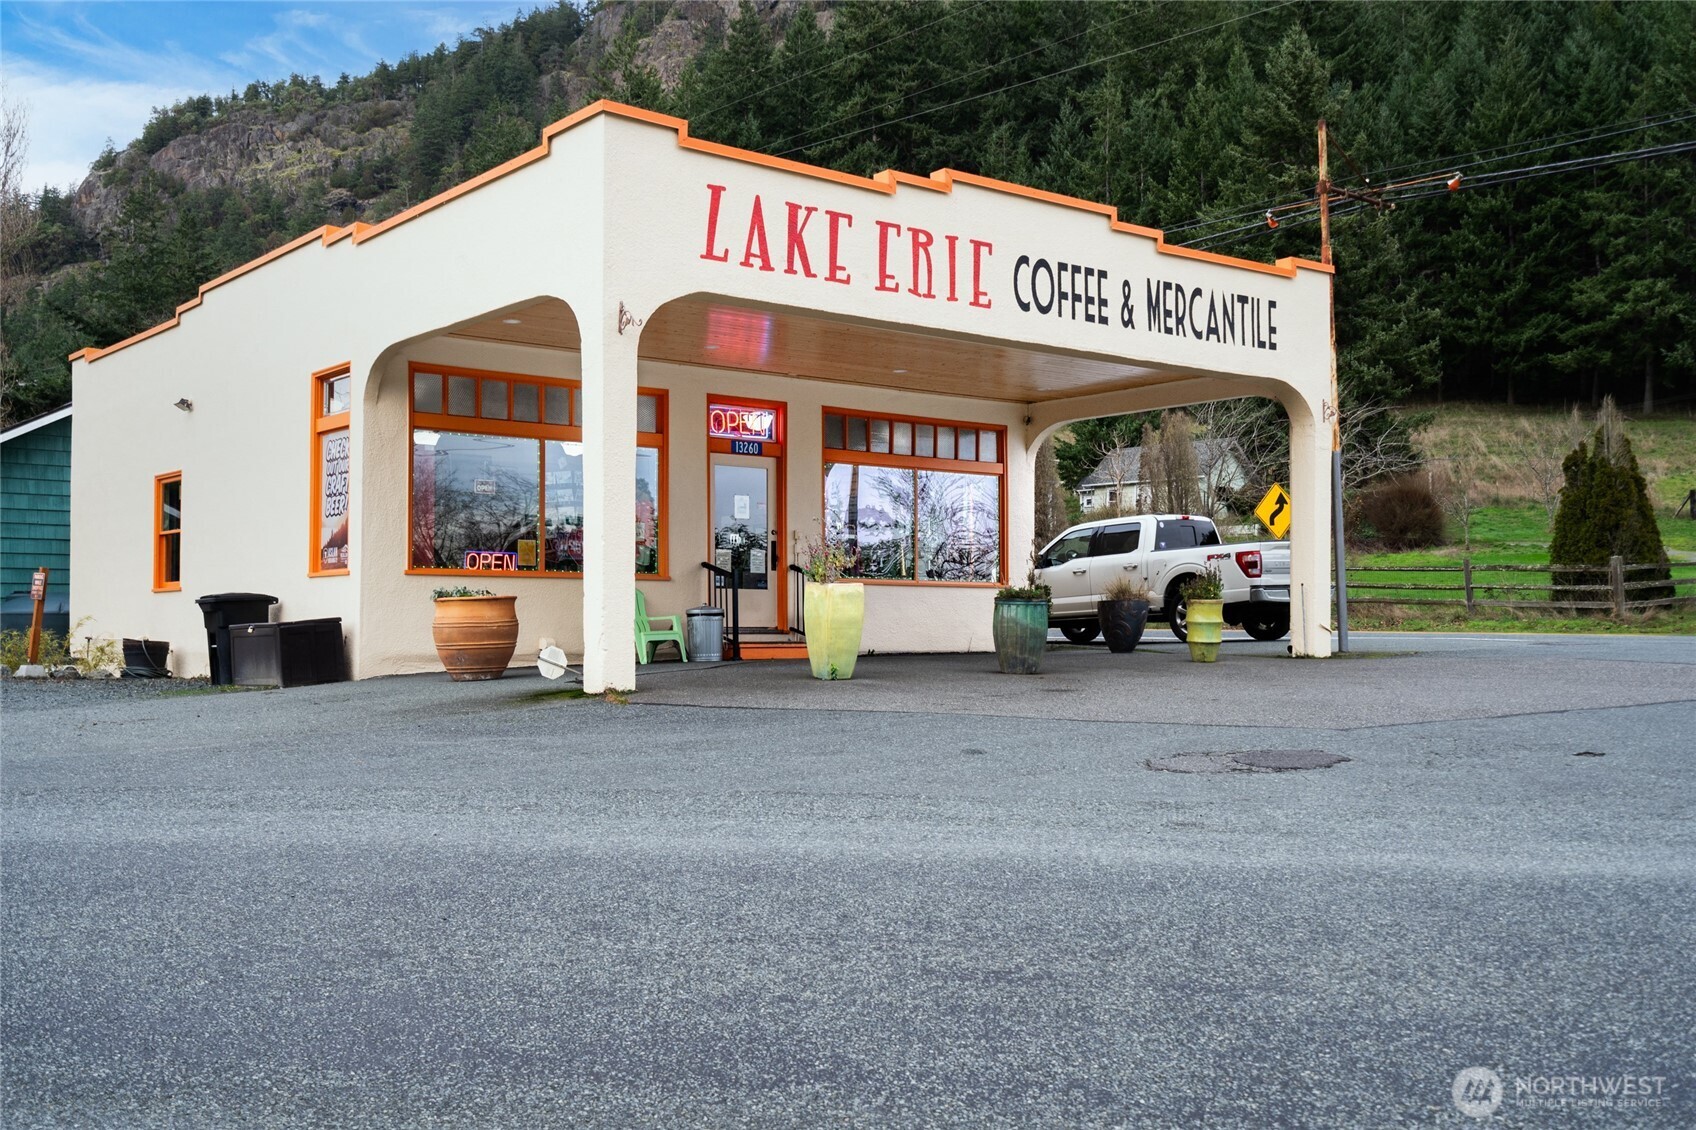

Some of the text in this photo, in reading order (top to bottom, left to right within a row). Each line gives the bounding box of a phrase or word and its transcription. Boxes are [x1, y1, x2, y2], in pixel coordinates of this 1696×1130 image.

[700, 184, 1277, 350] LAKE ERIE COFFEE & MERCANTILE
[711, 410, 765, 436] OPEN
[326, 437, 349, 462] CHECK
[735, 442, 759, 454] 13260
[325, 474, 349, 497] CRAFT
[476, 484, 493, 492] OPEN
[325, 494, 348, 518] BEER!
[467, 553, 516, 571] OPEN
